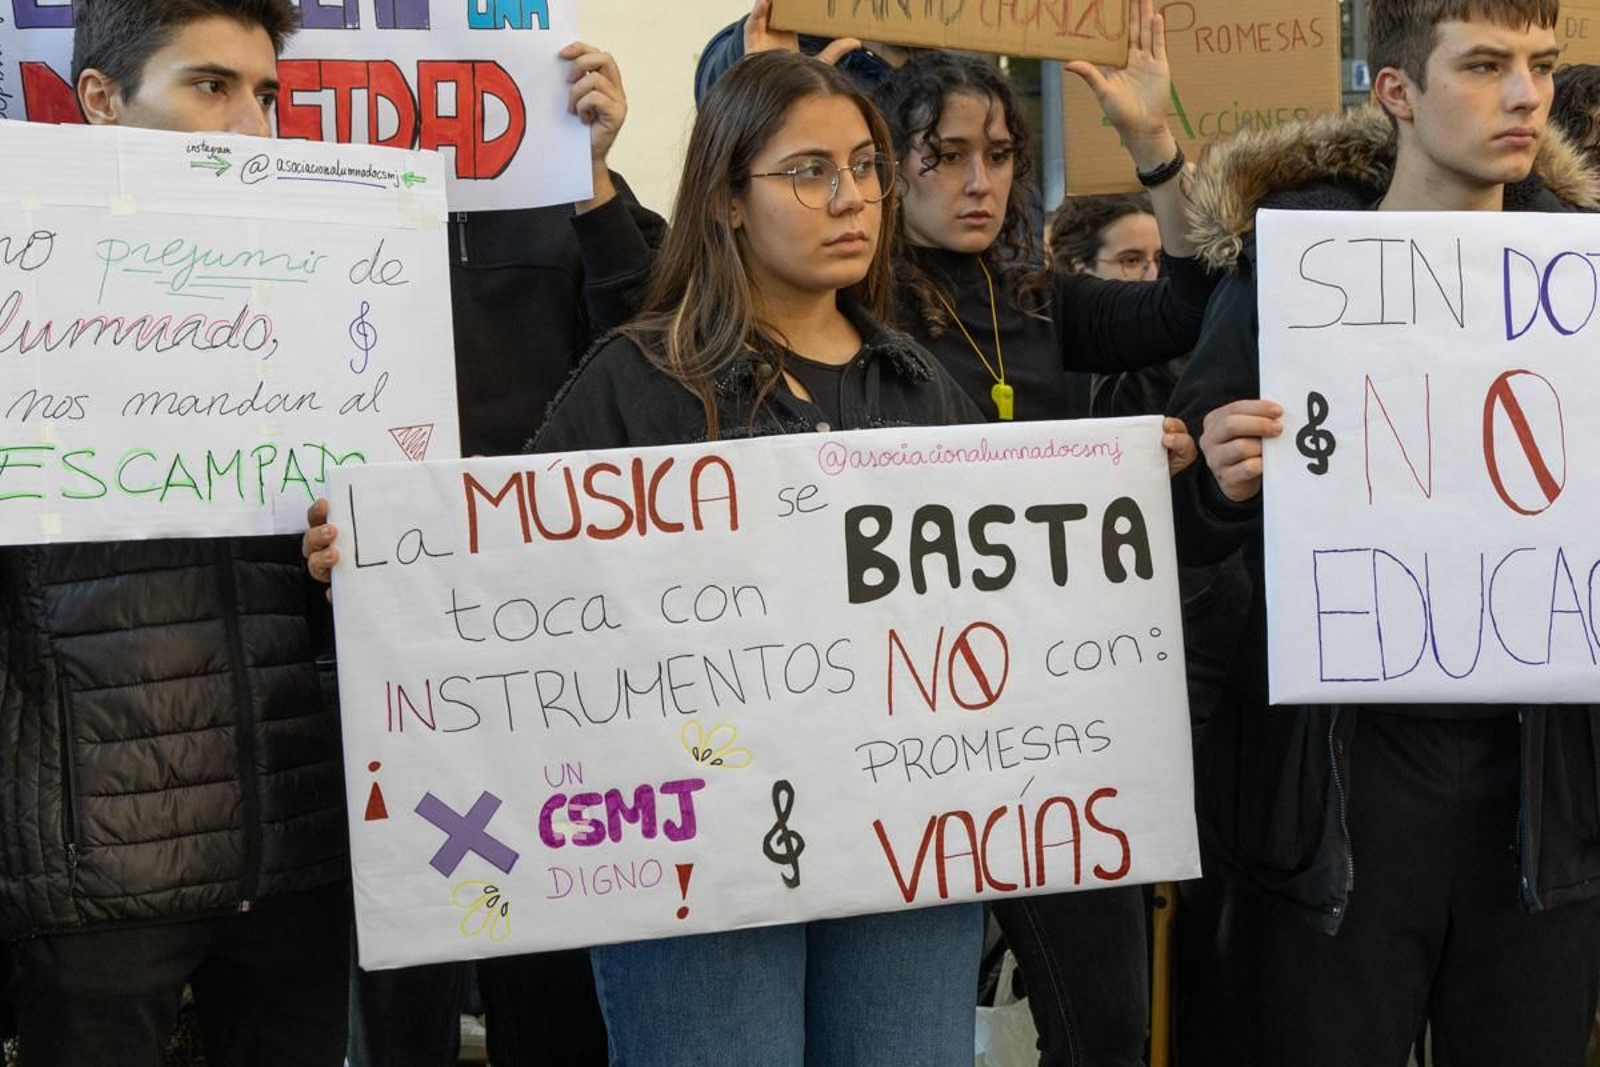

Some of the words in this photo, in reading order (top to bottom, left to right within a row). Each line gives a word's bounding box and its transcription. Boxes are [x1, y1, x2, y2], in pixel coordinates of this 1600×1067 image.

[1161, 2, 1324, 54] PROMESAS
[1565, 16, 1590, 39] DE
[186, 143, 233, 159] instagram
[349, 238, 409, 286] de
[1288, 238, 1464, 328] SIN
[1504, 247, 1600, 340] DO
[4, 389, 90, 421] nos
[121, 382, 323, 417] mandan
[339, 372, 389, 413] al
[818, 439, 1123, 476] @asociacionalumnadocsmj
[349, 484, 454, 568] La
[463, 455, 739, 554] MÚSICA
[777, 484, 829, 517] se
[844, 497, 1154, 604] BASTA
[444, 588, 621, 641] toca
[661, 584, 767, 623] con
[386, 638, 855, 732] INSTRUMENTOS
[887, 621, 1010, 716] NO
[544, 763, 584, 787] UN
[855, 720, 1112, 782] PROMESAS
[538, 778, 706, 849] CSMJ
[872, 776, 1131, 903] VACÍAS
